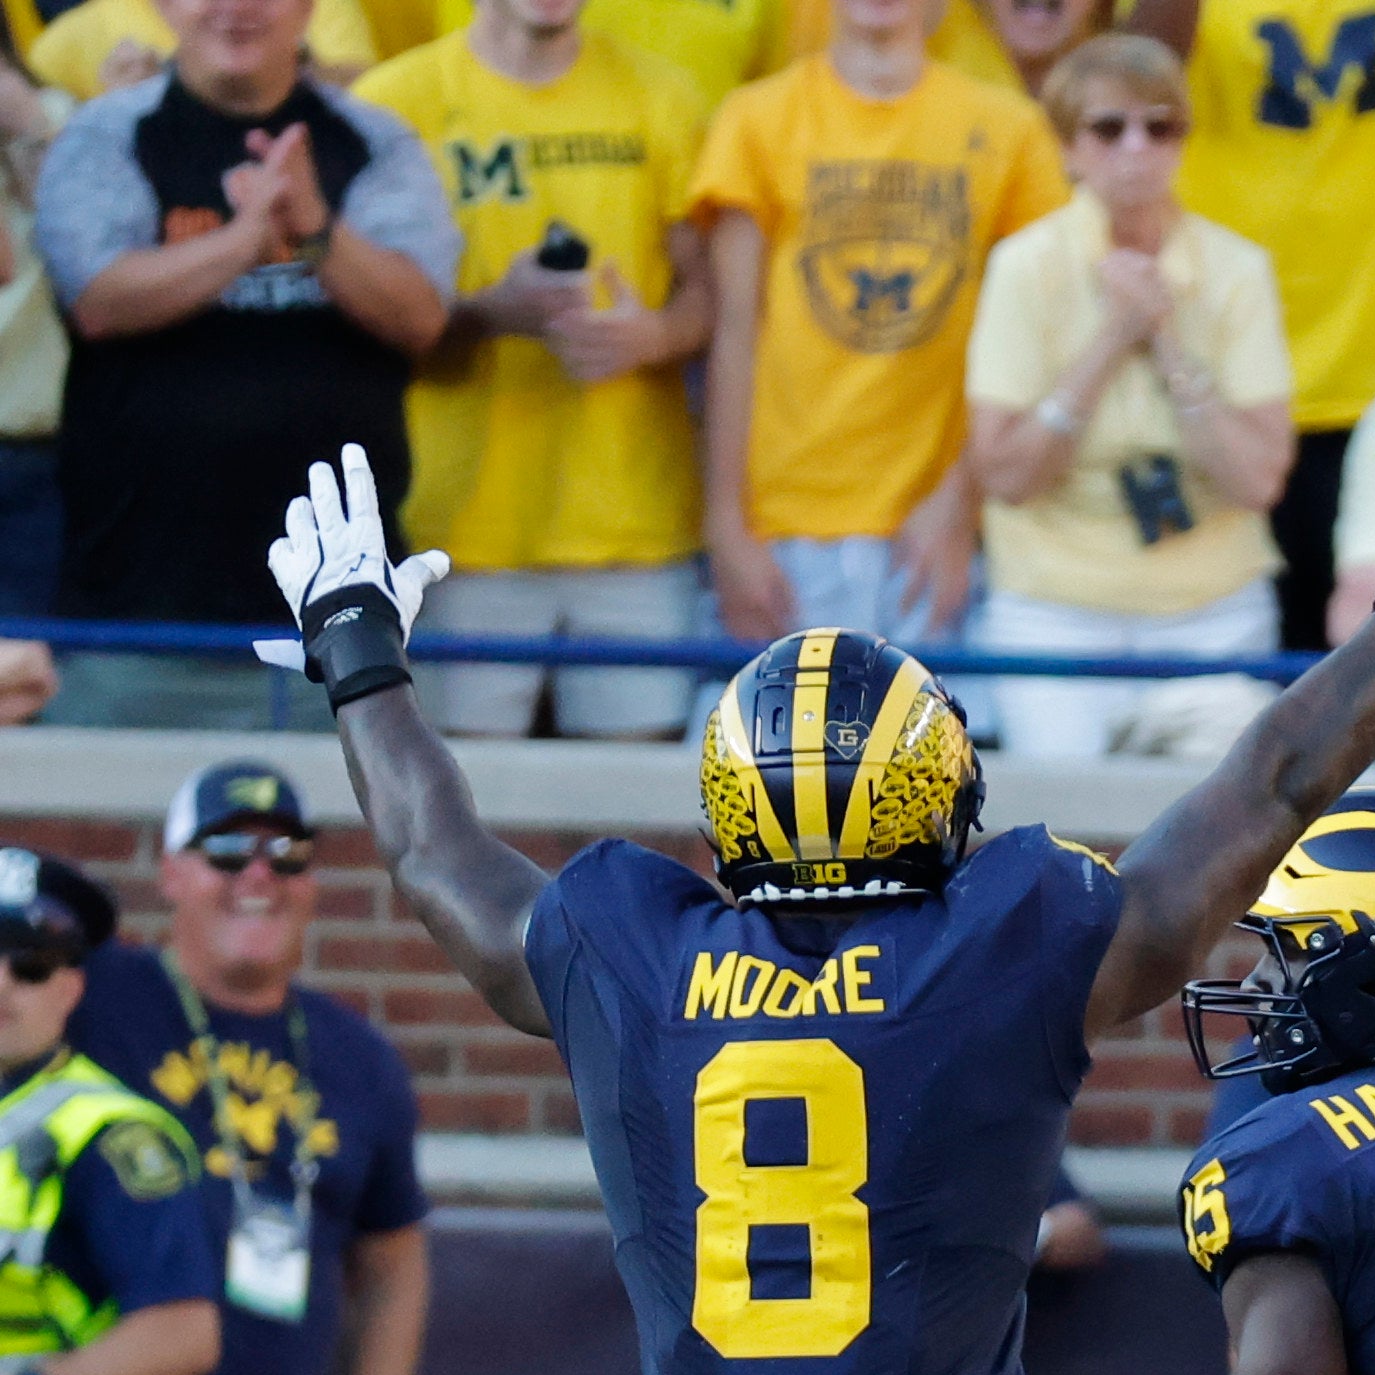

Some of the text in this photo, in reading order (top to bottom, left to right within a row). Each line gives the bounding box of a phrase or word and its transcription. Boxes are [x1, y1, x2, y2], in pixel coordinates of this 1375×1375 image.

[684, 944, 885, 1021] MOORE
[690, 1037, 872, 1360] 8
[1183, 1157, 1231, 1273] 15
